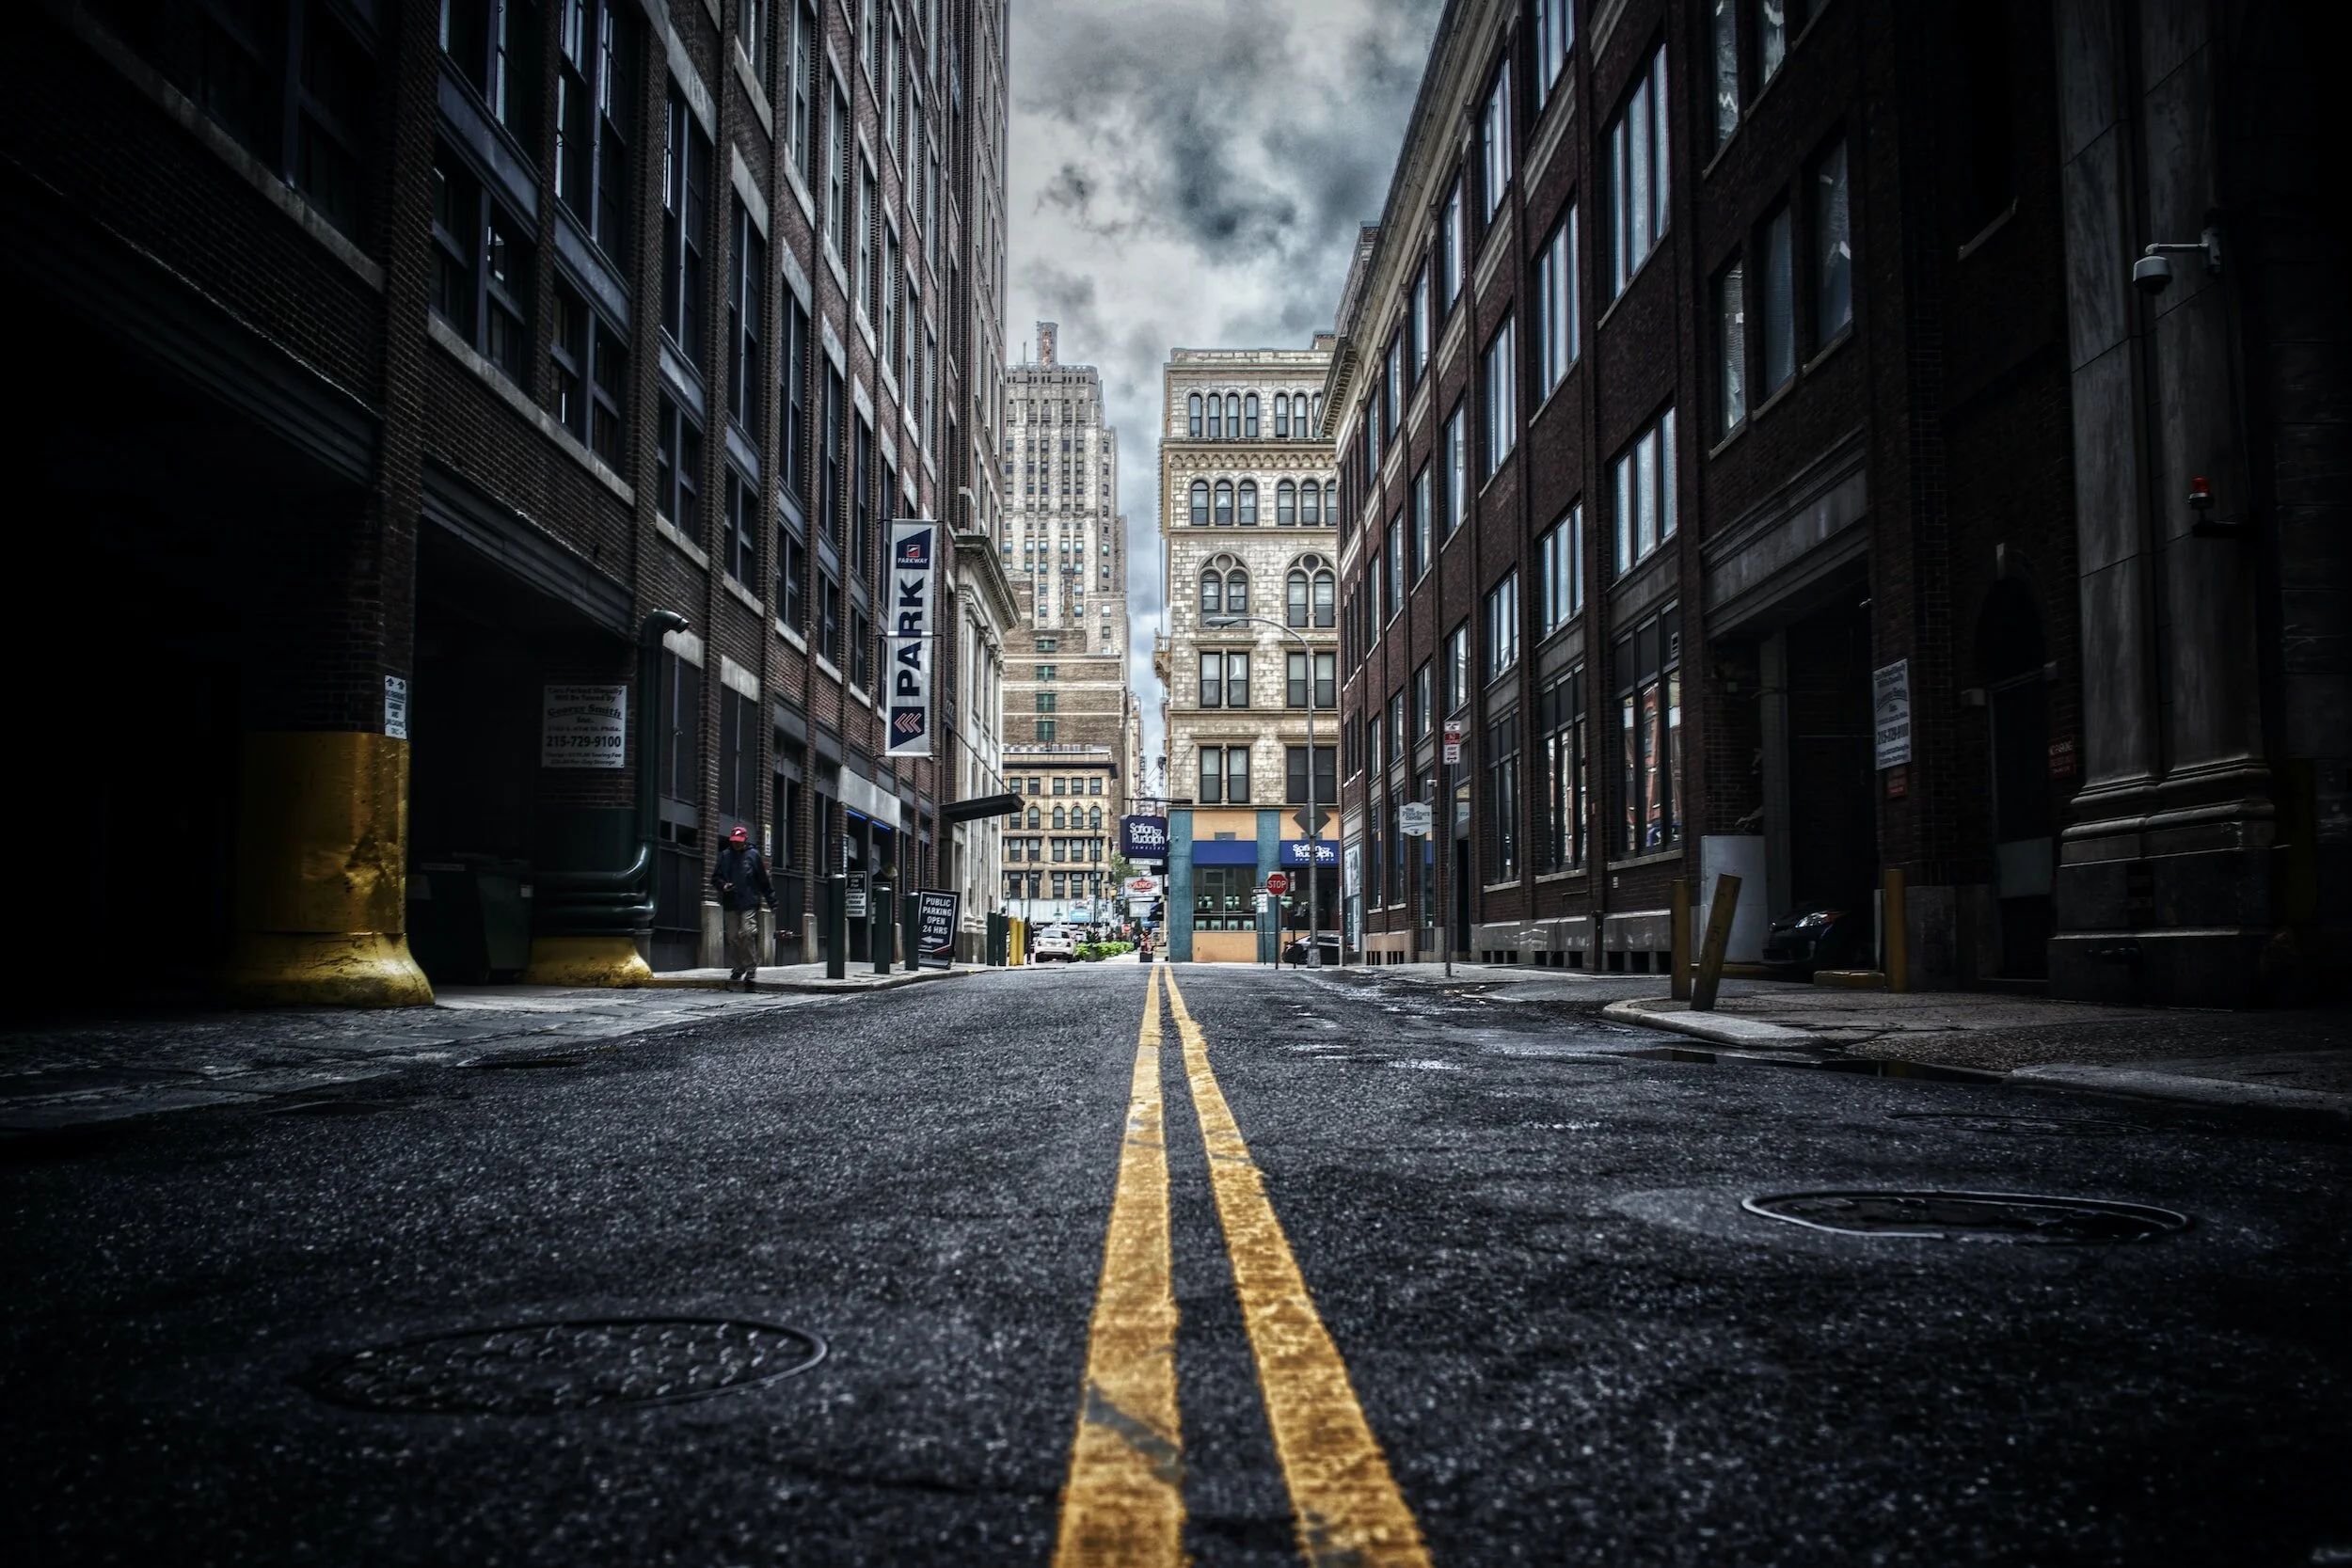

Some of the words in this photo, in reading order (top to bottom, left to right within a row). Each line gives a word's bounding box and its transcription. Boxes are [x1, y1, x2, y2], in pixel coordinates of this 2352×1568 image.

[897, 578, 924, 696] PARK
[548, 706, 585, 716] George
[588, 704, 622, 718] Smith
[546, 736, 621, 747] 215-729-9100
[1132, 833, 1165, 847] Rudolph
[1267, 880, 1287, 889] STOP
[926, 897, 951, 907] PUBLIC
[922, 906, 952, 916] PARKING
[927, 916, 946, 926] OPEN
[932, 926, 948, 935] HRS
